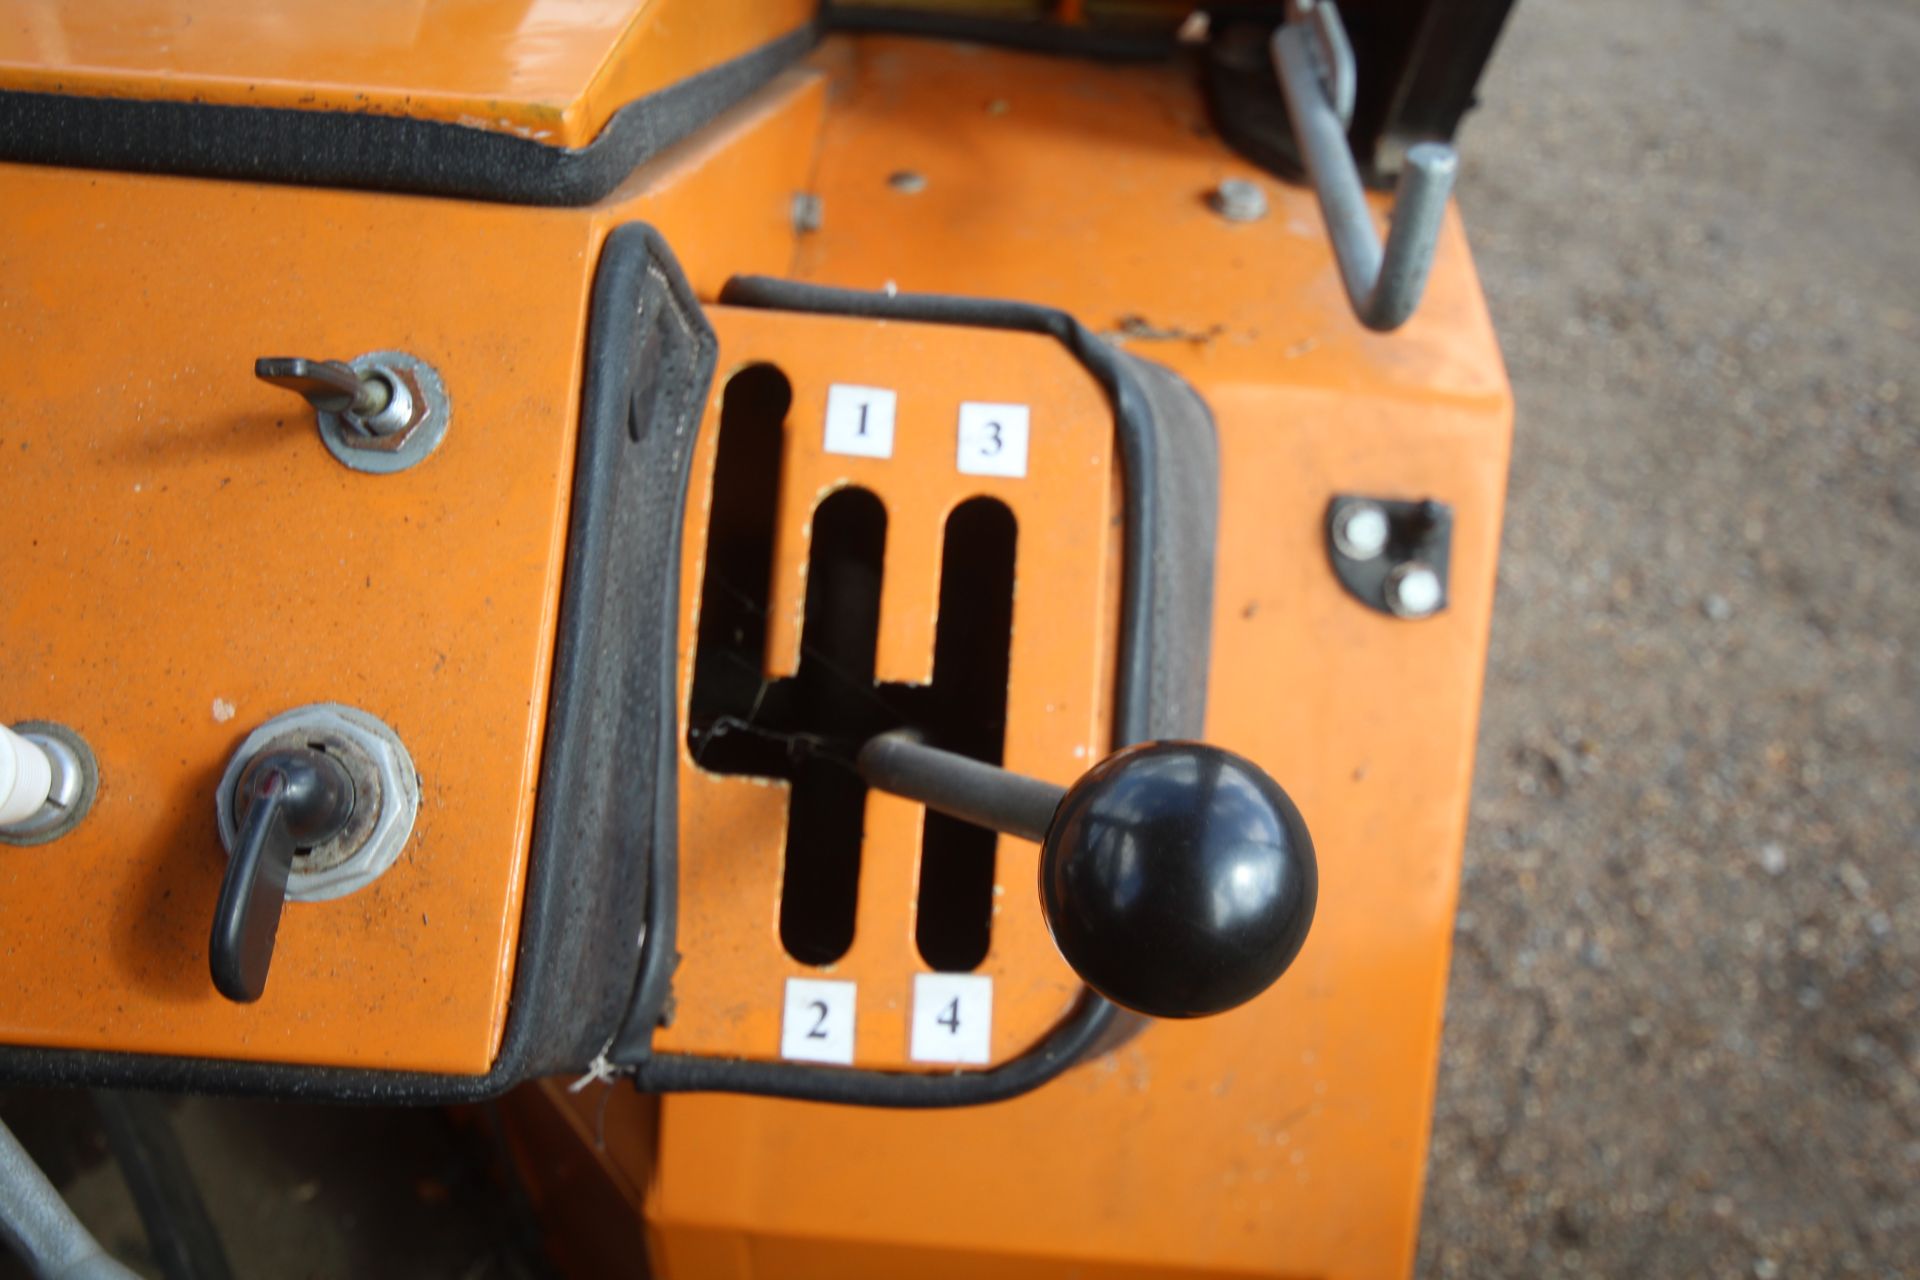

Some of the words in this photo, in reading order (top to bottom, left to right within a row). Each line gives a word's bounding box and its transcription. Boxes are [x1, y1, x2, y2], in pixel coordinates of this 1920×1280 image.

[855, 403, 869, 436] 1
[980, 421, 1003, 455] 3
[806, 1000, 829, 1039] 2
[936, 997, 961, 1034] 4
